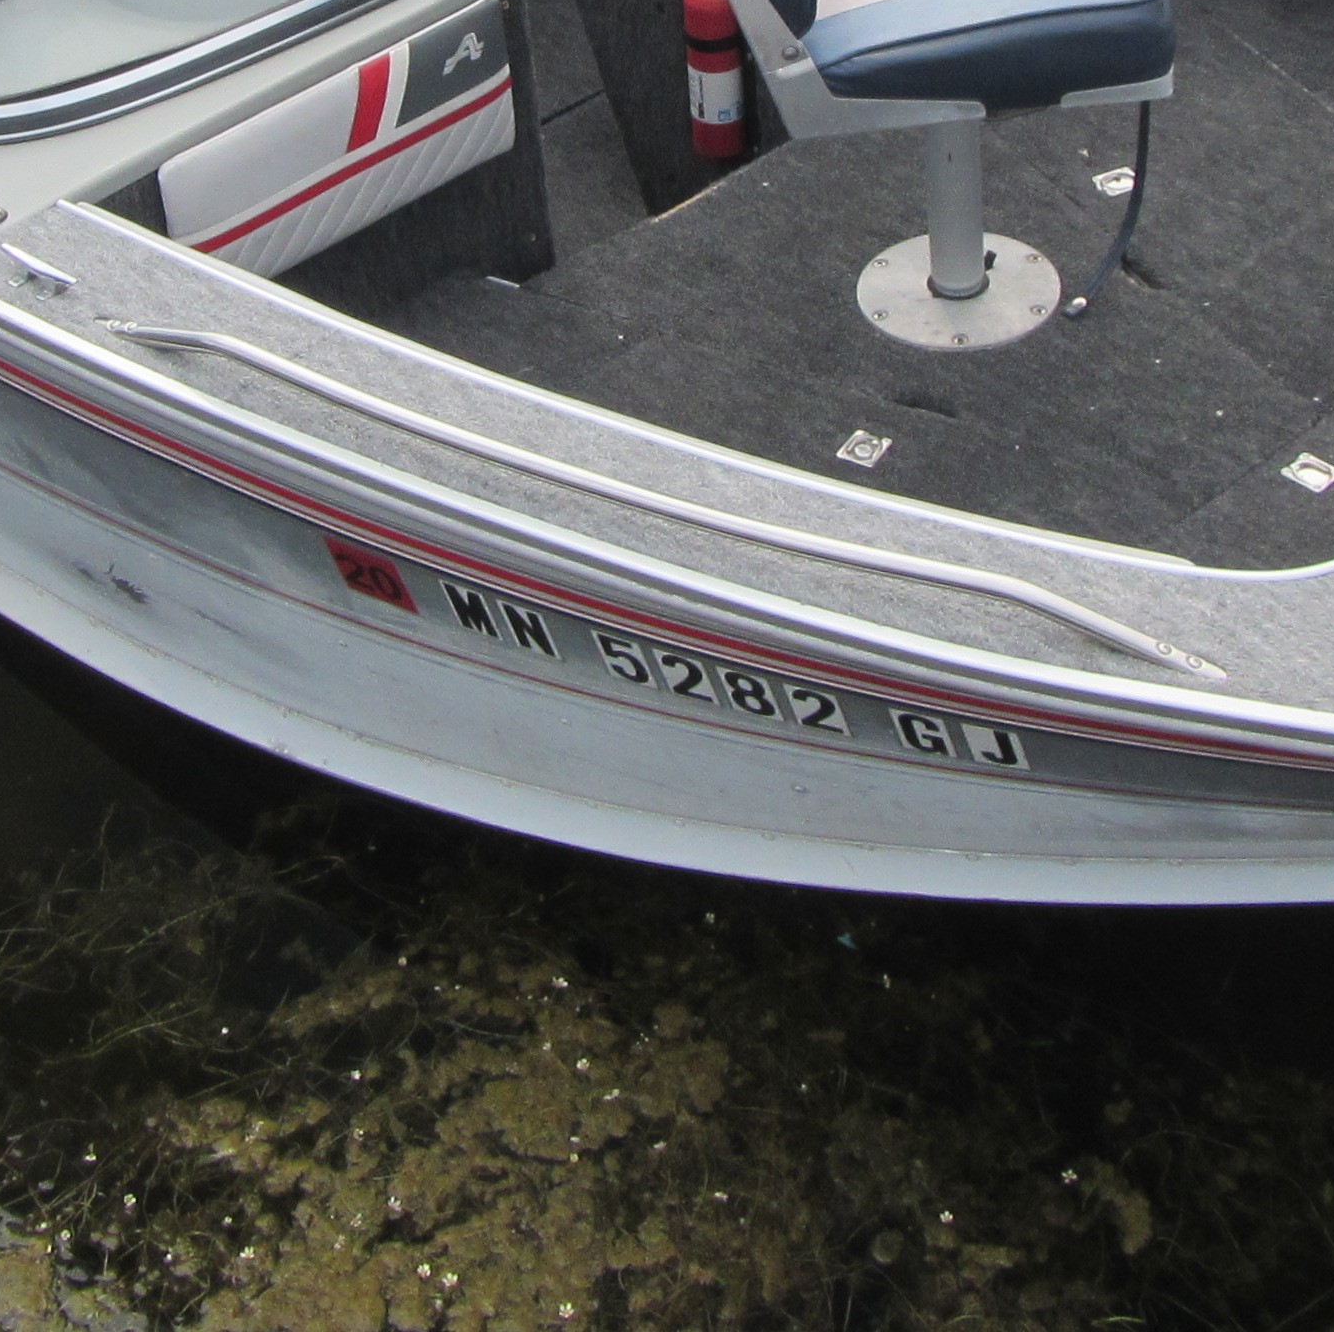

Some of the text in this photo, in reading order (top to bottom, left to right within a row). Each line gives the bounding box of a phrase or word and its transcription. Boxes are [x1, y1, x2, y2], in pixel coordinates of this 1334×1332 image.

[335, 550, 402, 601] 20
[441, 579, 1018, 766] MN 5282 GJ
